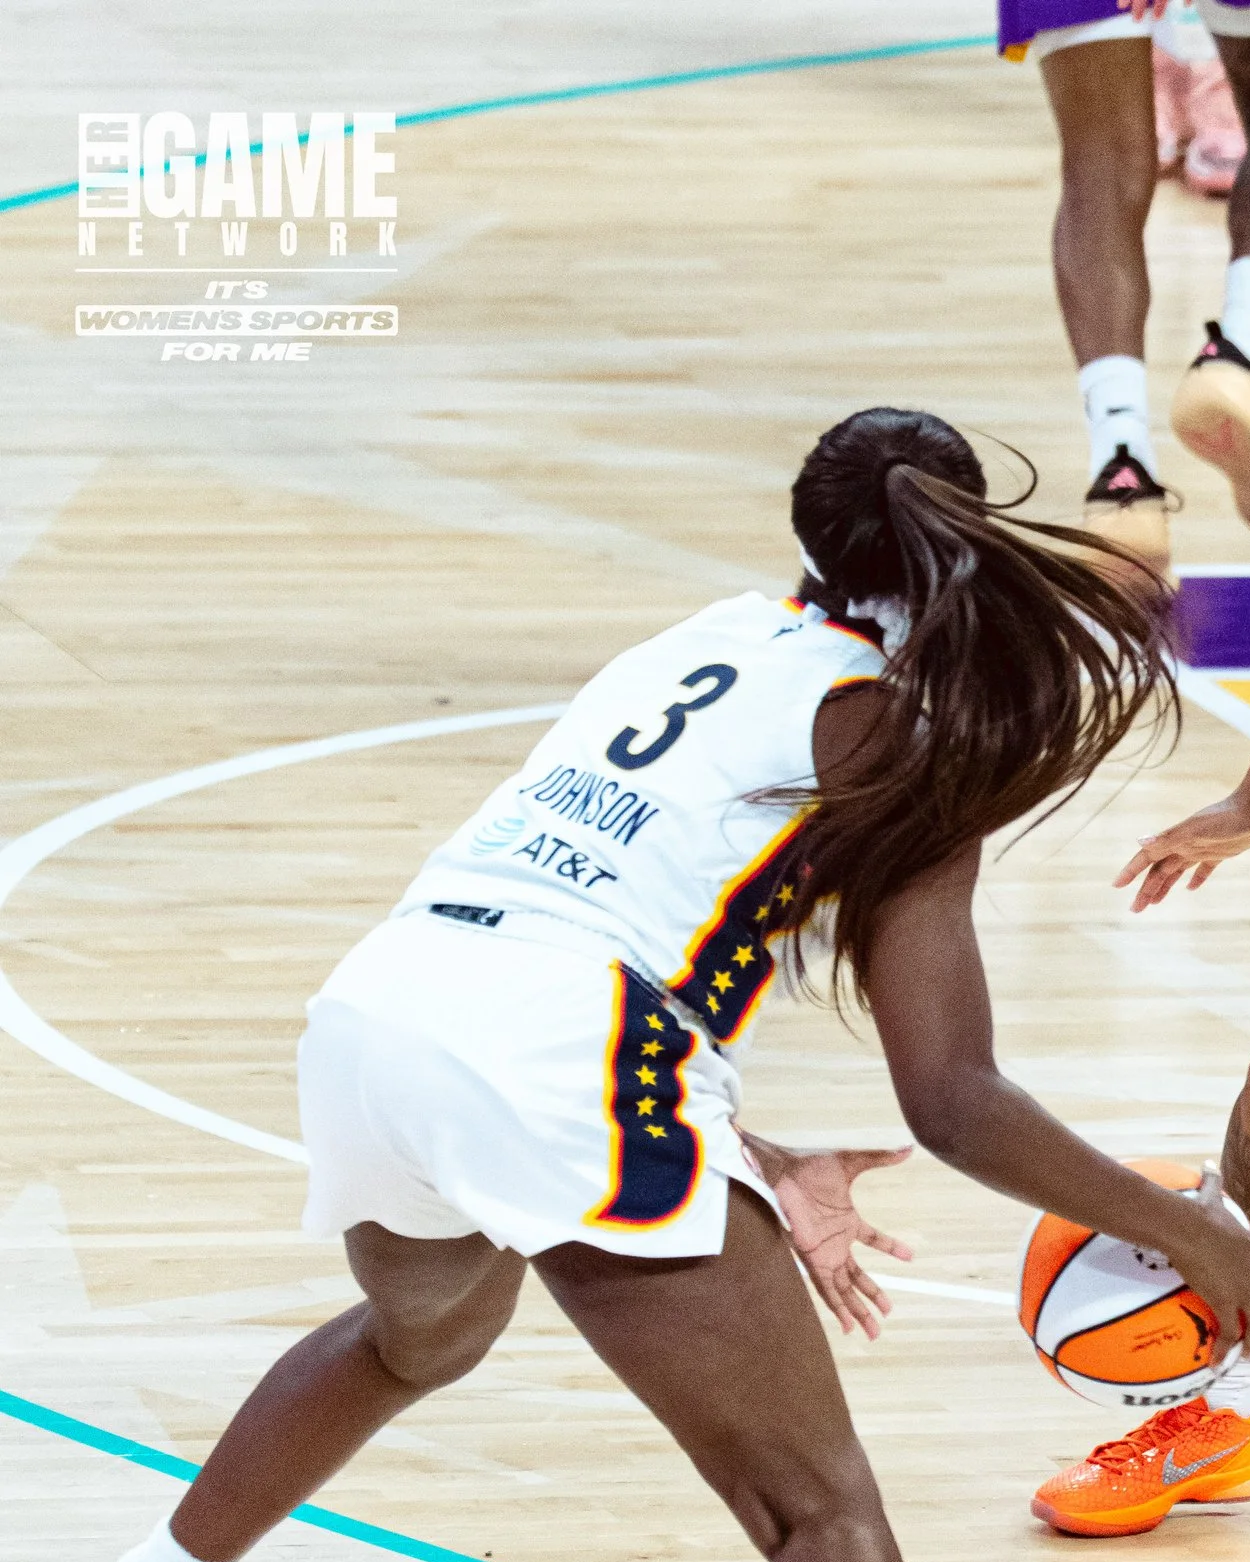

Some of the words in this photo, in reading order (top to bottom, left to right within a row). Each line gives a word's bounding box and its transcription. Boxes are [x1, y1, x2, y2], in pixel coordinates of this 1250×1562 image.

[606, 663, 738, 771] 3
[519, 764, 660, 846] JOHNSON
[511, 833, 618, 888] AT&T
